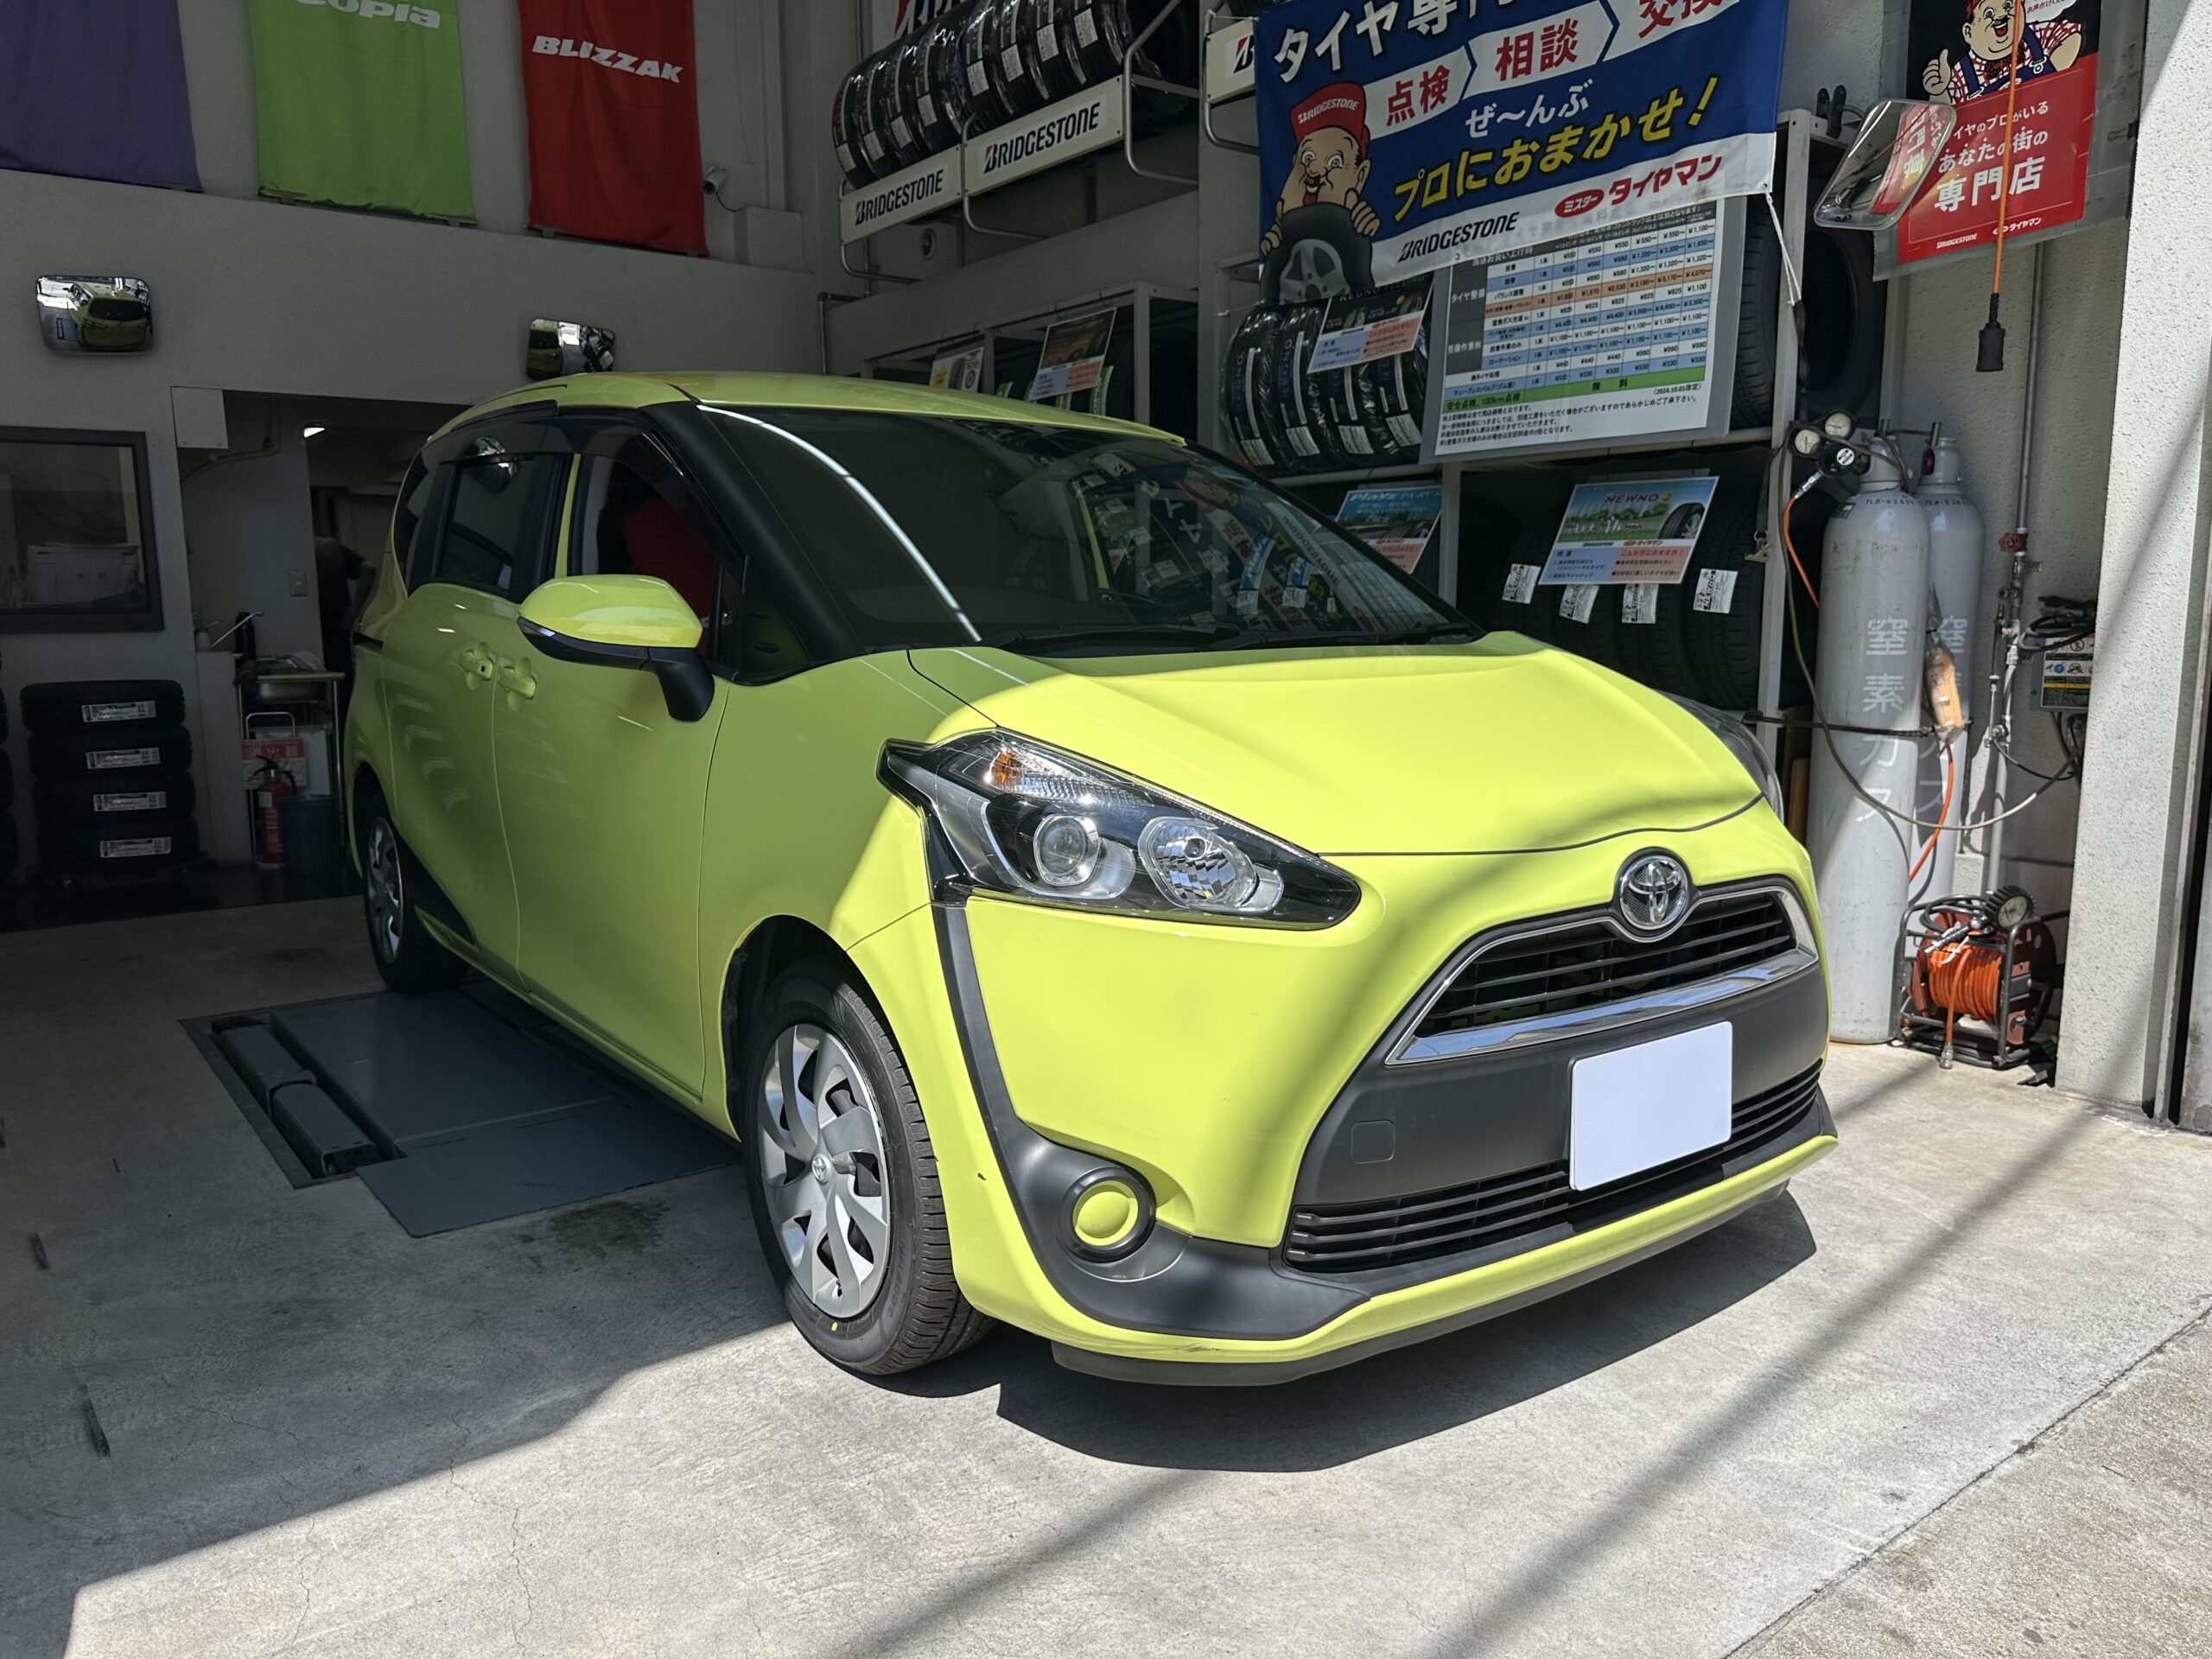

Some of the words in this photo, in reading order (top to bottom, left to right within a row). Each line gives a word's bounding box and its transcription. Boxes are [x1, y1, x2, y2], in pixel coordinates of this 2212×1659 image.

[531, 35, 683, 84] BLIZZAK
[1495, 17, 1577, 81] 相談
[1298, 98, 1359, 124] BRIDGESTONE
[1386, 65, 1450, 126] 点検
[984, 102, 1100, 175] BRIDGESTONE
[855, 169, 944, 226] BRIDGESTONE
[1563, 193, 1599, 213] ミスター
[1608, 156, 1722, 206] タイヤマン
[1935, 156, 2045, 213] 専門店
[1398, 212, 1520, 263] BRIDGESTONE
[1936, 232, 1978, 249] BRIDGESTONE
[2007, 217, 2042, 232] タイヤマン
[1605, 493, 1659, 504] NEWNO
